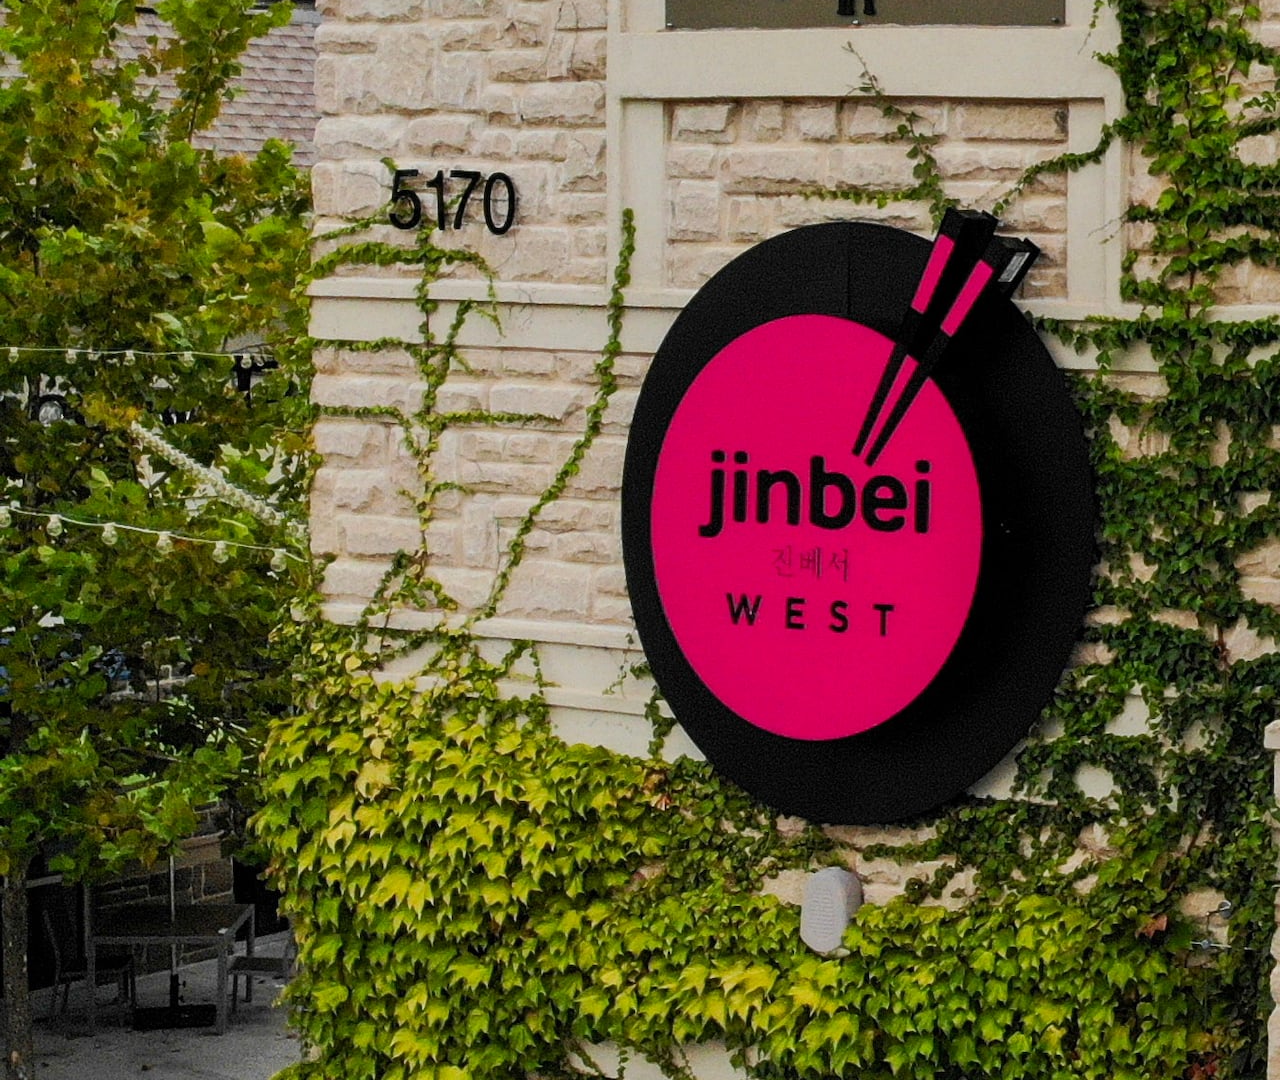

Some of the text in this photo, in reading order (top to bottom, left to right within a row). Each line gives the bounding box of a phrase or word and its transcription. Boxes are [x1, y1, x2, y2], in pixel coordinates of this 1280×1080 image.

[389, 169, 515, 235] 5170
[699, 450, 932, 538] jinbei
[771, 545, 849, 582] 진베서
[725, 592, 895, 637] WEST
